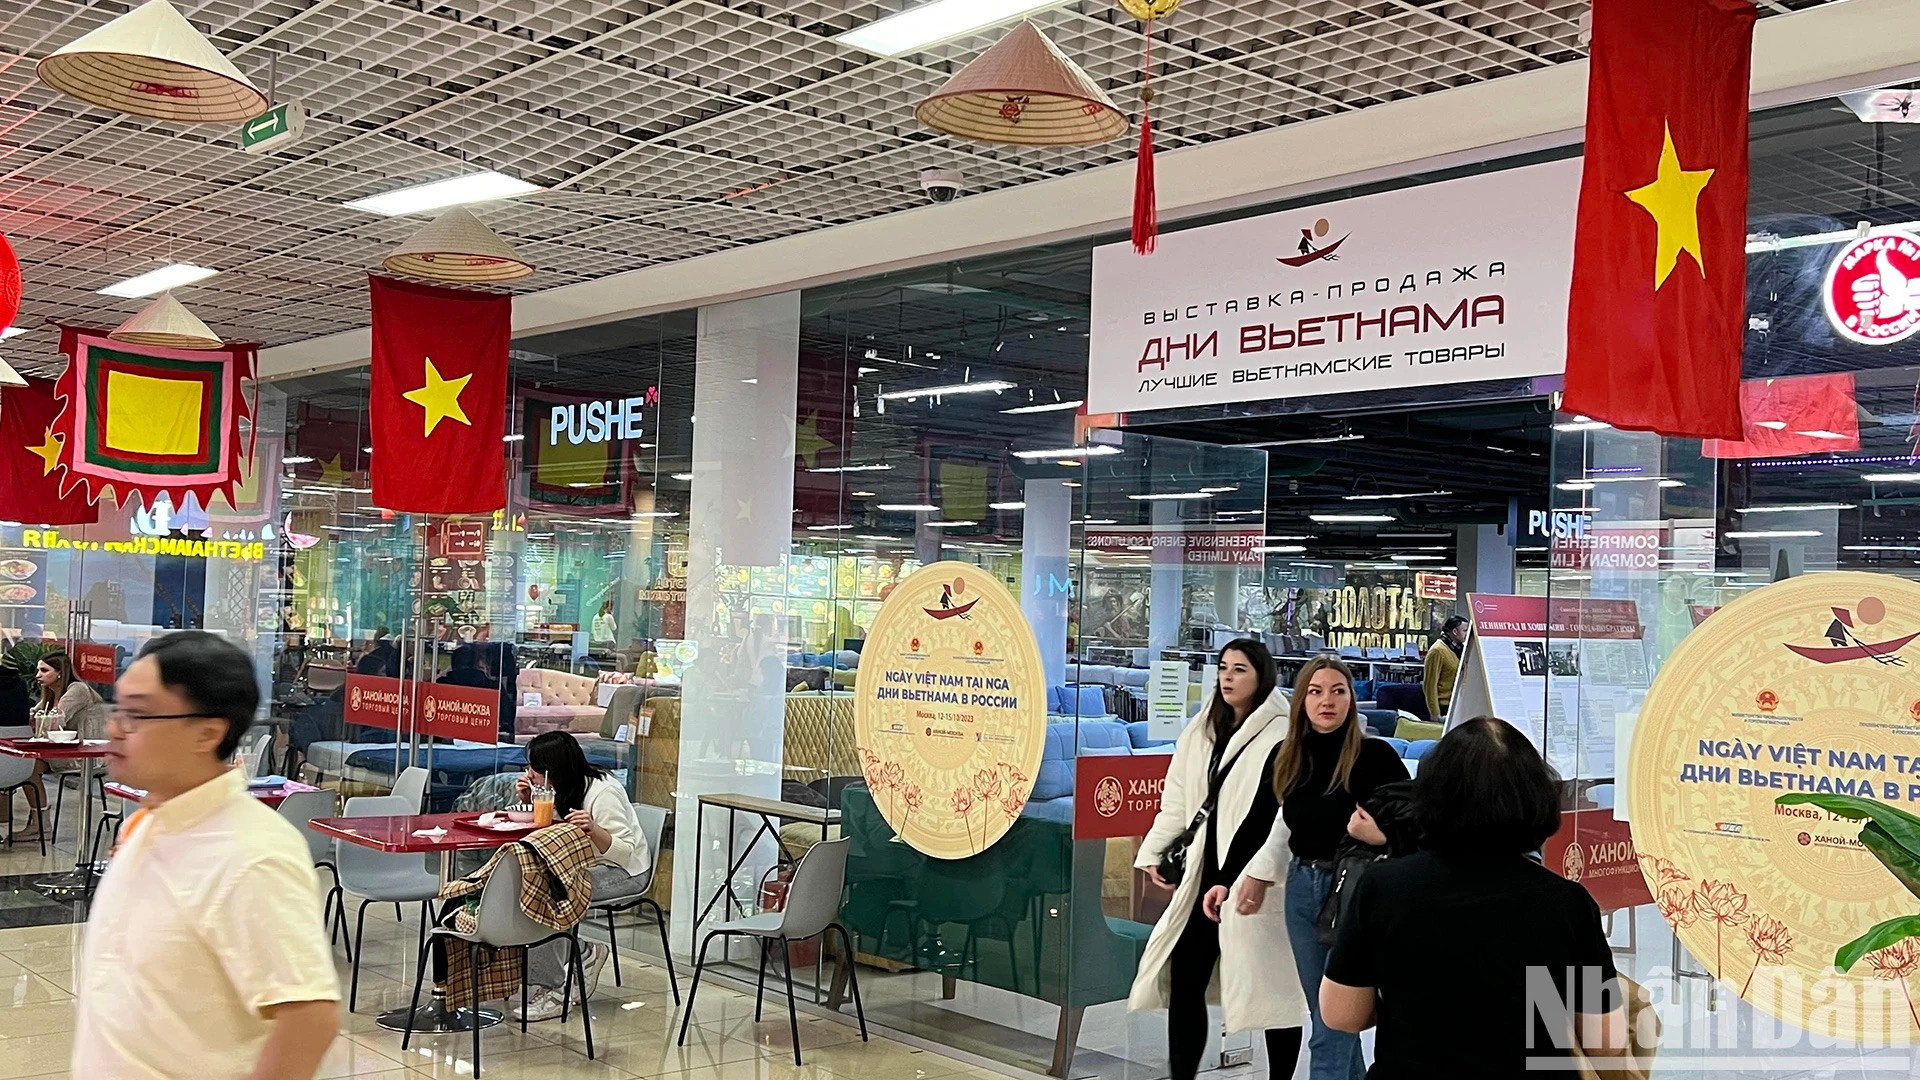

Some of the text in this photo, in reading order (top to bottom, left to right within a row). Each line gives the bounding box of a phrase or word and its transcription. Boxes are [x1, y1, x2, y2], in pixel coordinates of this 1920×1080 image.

[1144, 262, 1505, 325] ВЫСТАВКА-ПРОДАЖА
[1138, 294, 1504, 373] ДНИ ВЬЕТНАМА
[1138, 342, 1505, 393] ЛУЧШИЕ ВЬЕТНАМСКИЕ ТОВАРЫ
[550, 396, 644, 446] PUSHE
[1529, 510, 1592, 540] PUSHE
[885, 670, 913, 684] NGÀY
[939, 675, 963, 687] NAM
[986, 678, 1009, 691] NGA
[437, 699, 491, 717] ХАНОЙ-МОСКВА
[877, 687, 1017, 709] ДНИ ВЬЕТНАМА В РОССИИ
[437, 712, 491, 727] ТОРГОВЫЙ ЦЕНТР
[1699, 738, 1762, 761] NGÀY
[1768, 742, 1821, 769] VIỆT
[1829, 750, 1886, 772] NAM
[1680, 763, 1731, 784] ДНИ
[1738, 768, 1875, 799] ВЬЕТНАМА
[1884, 782, 1900, 801] В
[1127, 799, 1160, 811] ТОРГ
[1774, 804, 1822, 821] Москва,
[1589, 837, 1638, 865] ХАНОЙ
[1815, 835, 1864, 848] ХАНОЙ-МО
